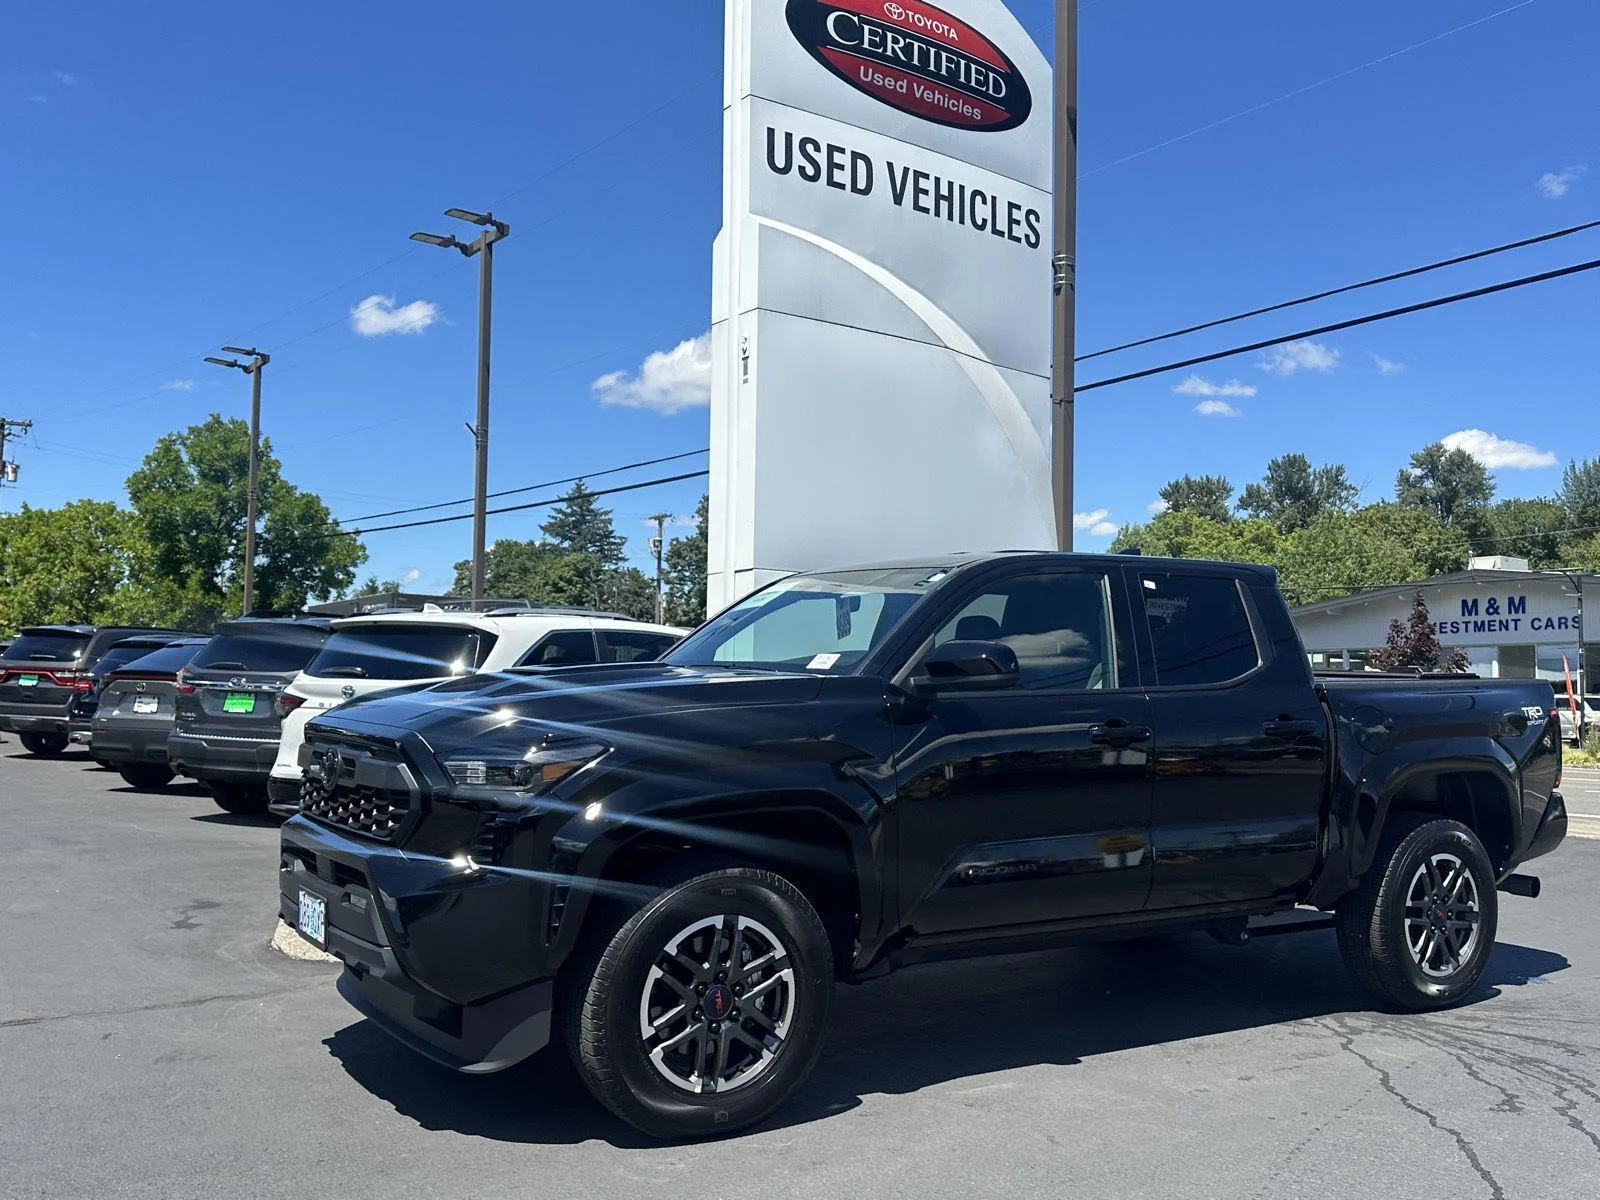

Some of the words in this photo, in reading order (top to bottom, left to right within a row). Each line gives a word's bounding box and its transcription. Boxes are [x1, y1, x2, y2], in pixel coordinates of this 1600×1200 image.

[906, 9, 959, 41] TOYOTA
[826, 10, 1006, 98] CERTIFIED
[859, 65, 907, 94] Used
[912, 82, 982, 121] Vehicles
[766, 126, 874, 197] USED
[886, 160, 1041, 250] VEHICLES
[1461, 598, 1479, 617] M
[1485, 597, 1500, 616] &
[1507, 595, 1526, 615] M
[1437, 619, 1521, 634] ESTMENT
[1531, 616, 1580, 631] CARS
[1521, 706, 1543, 719] TRD
